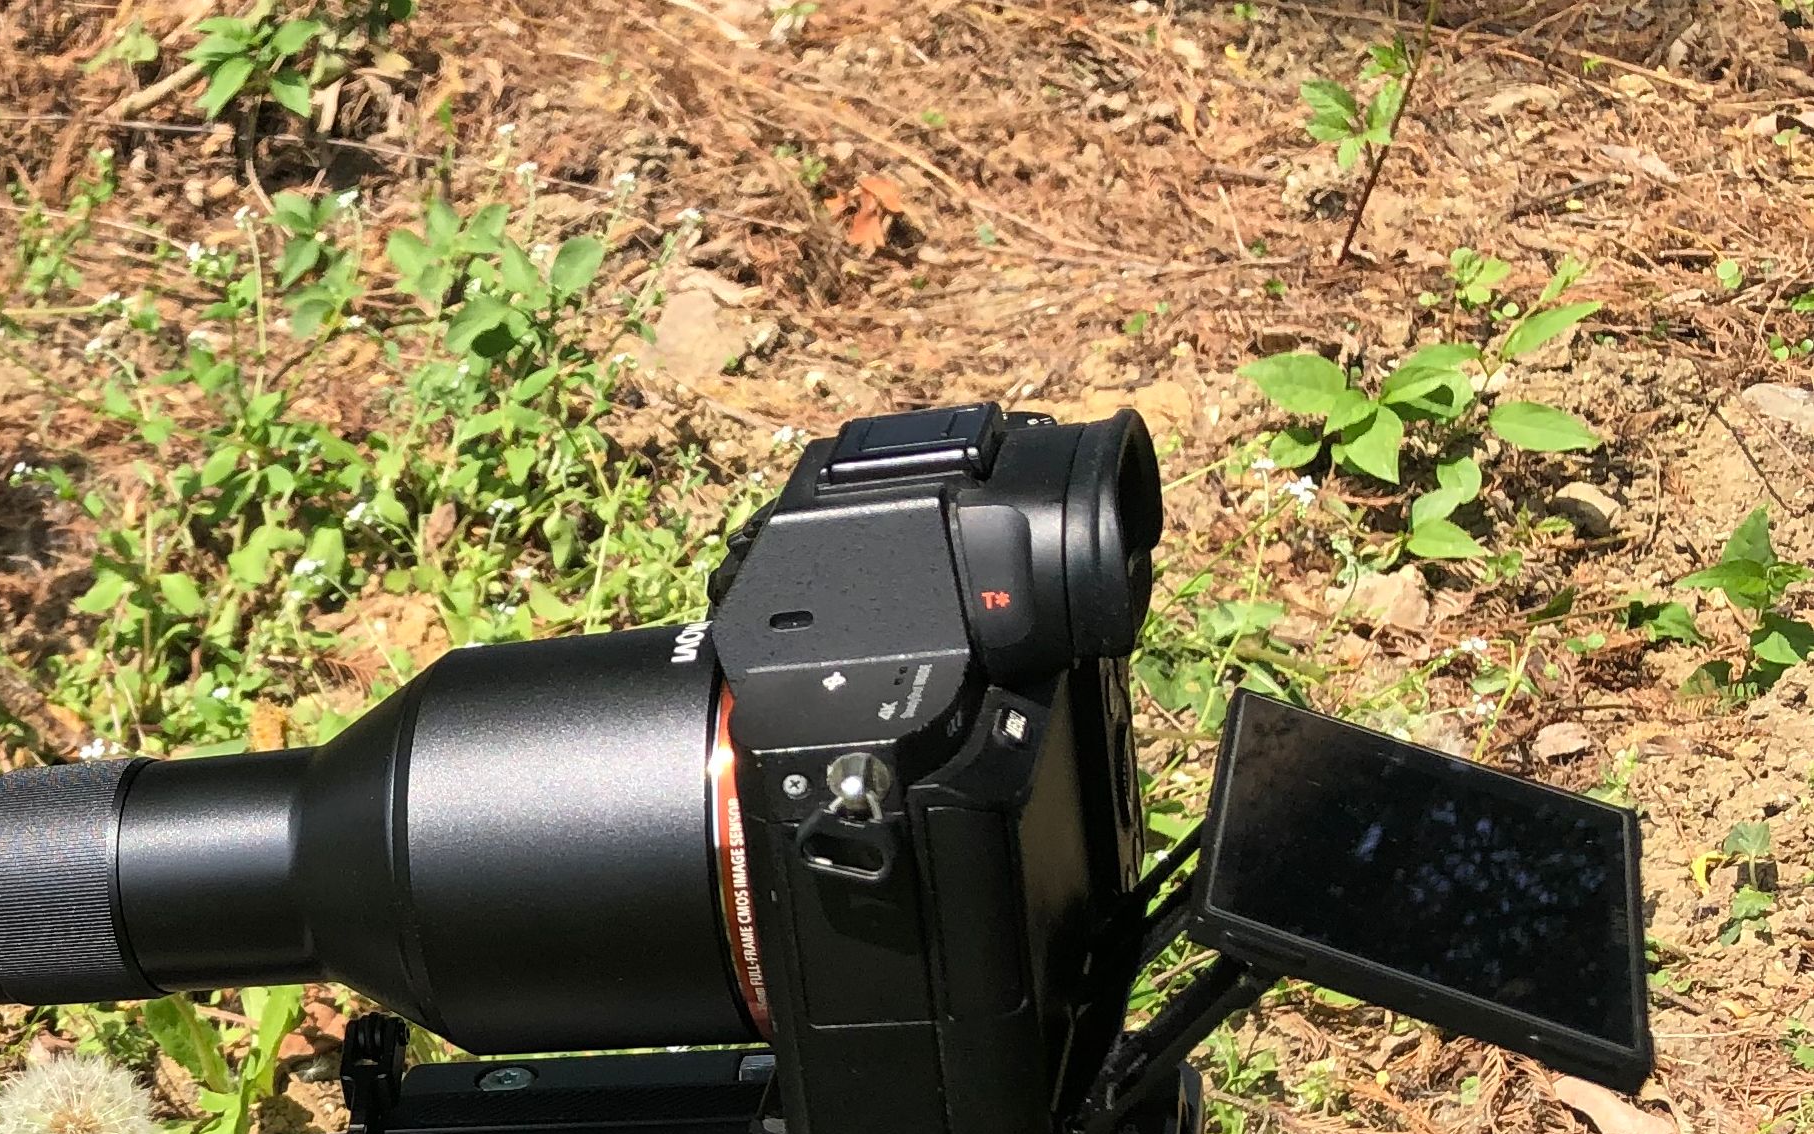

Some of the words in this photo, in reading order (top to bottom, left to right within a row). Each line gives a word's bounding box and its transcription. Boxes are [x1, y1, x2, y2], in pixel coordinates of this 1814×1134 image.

[670, 620, 714, 663] LAOW
[727, 797, 744, 846] SENSOR
[730, 848, 748, 888] IMAGE
[734, 890, 752, 923] CMOS
[740, 925, 763, 986] FULL-FRAME
